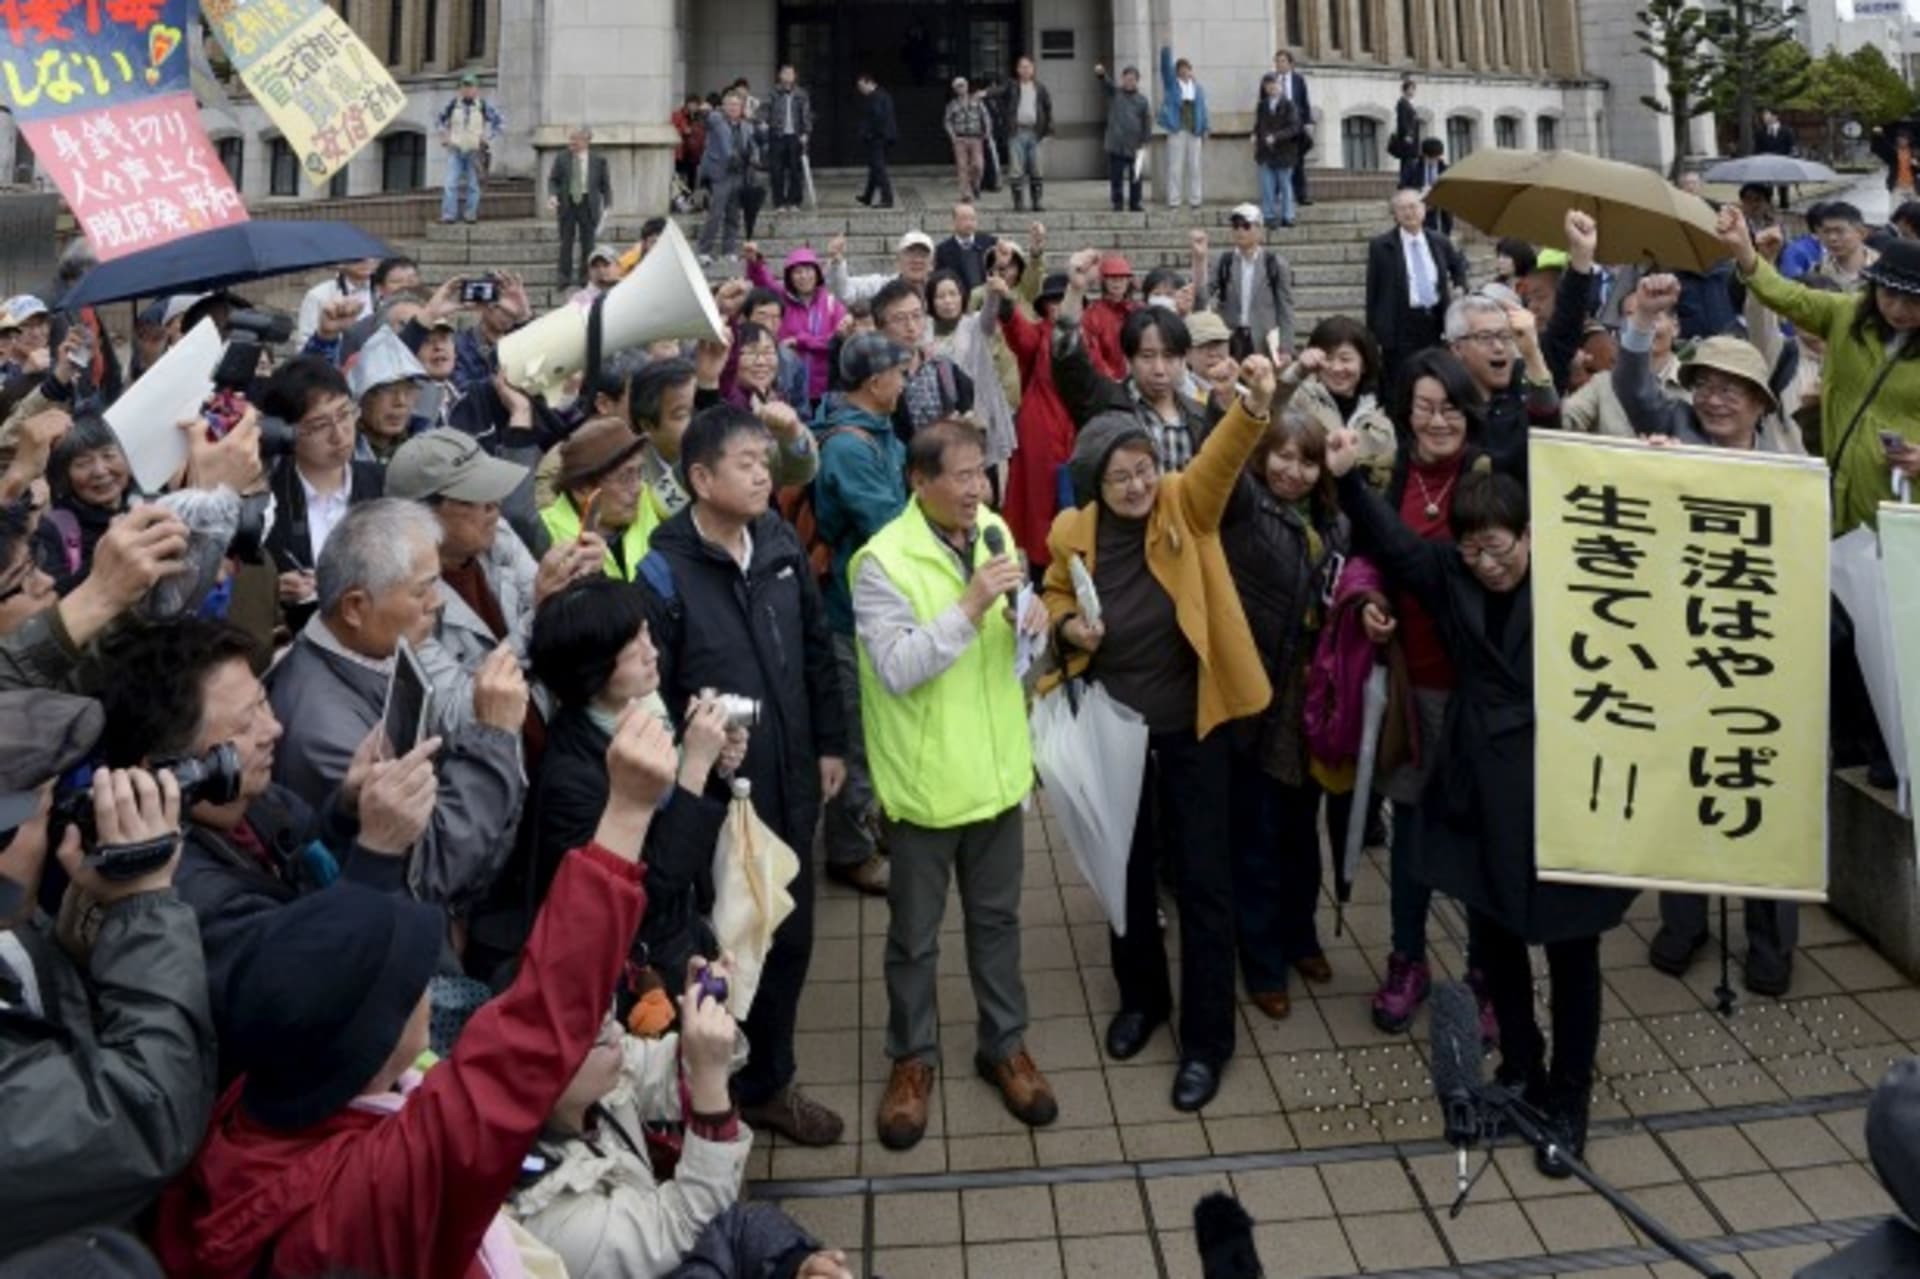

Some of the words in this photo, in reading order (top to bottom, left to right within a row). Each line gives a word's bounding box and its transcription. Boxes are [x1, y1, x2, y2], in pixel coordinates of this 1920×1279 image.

[1562, 484, 1658, 820] 生きていた!!
[1679, 494, 1782, 839] 司法はやっぱり
